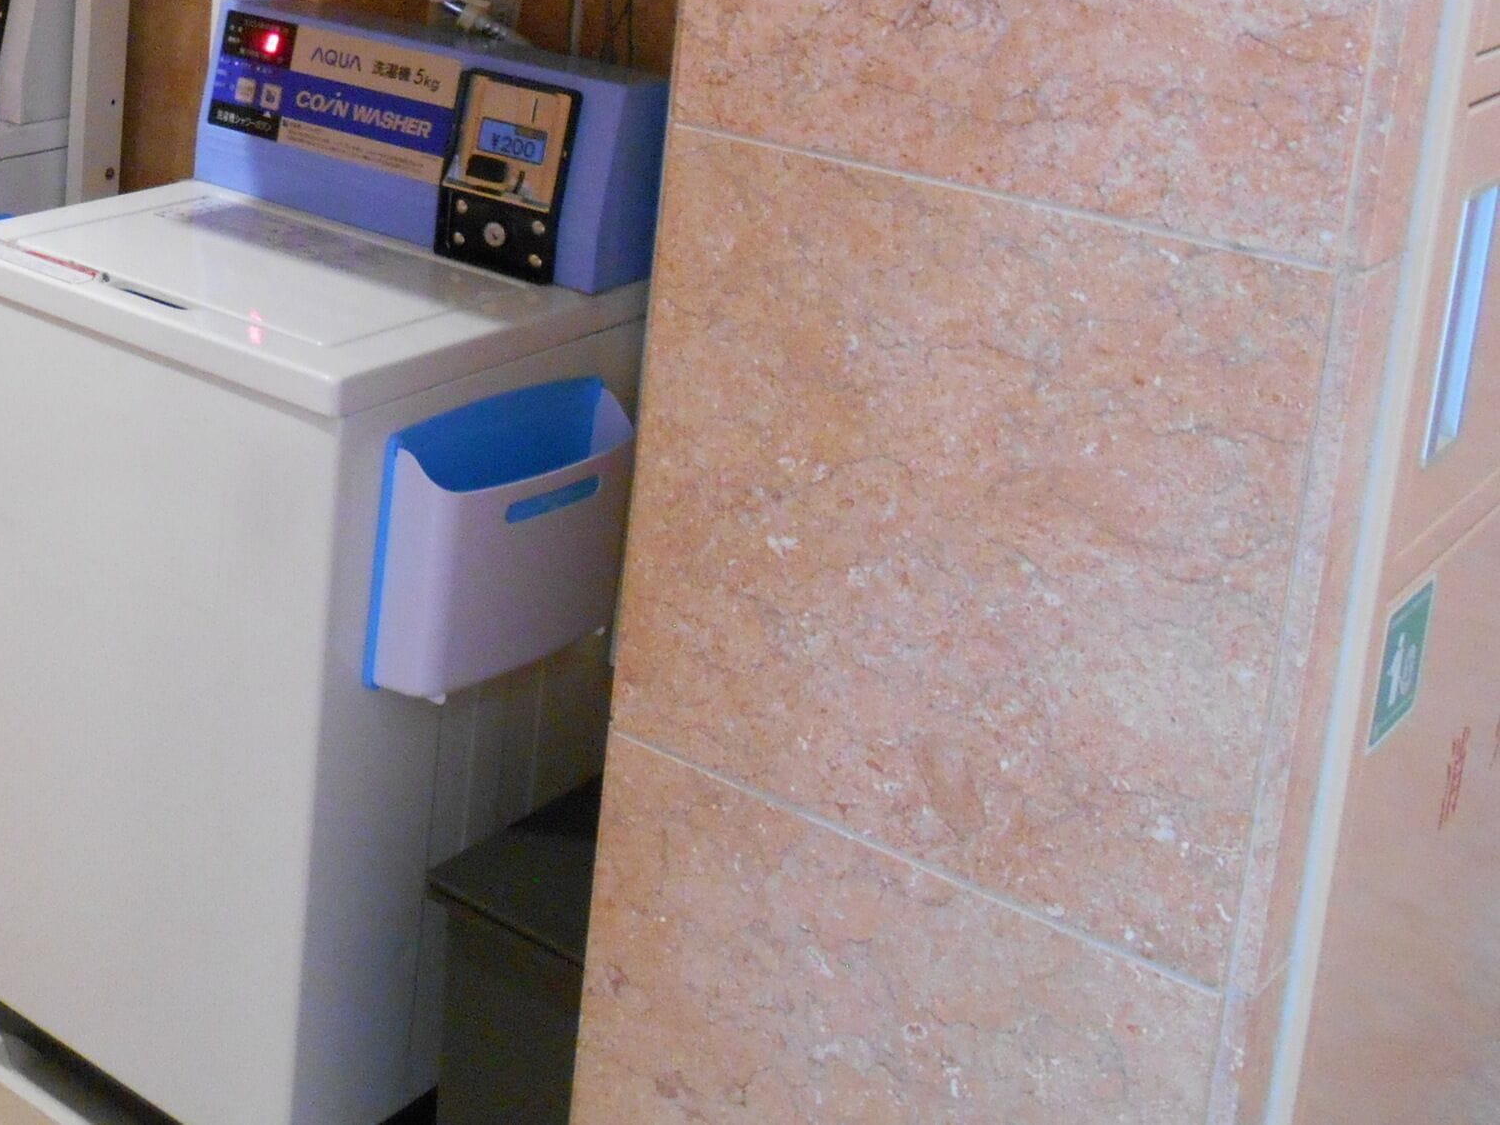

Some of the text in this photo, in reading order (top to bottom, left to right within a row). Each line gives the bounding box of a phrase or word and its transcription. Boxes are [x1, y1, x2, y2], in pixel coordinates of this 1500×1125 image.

[310, 47, 362, 73] AQUA
[413, 68, 441, 93] 5kg
[353, 104, 434, 139] WASHER
[491, 132, 536, 158] ¥200
